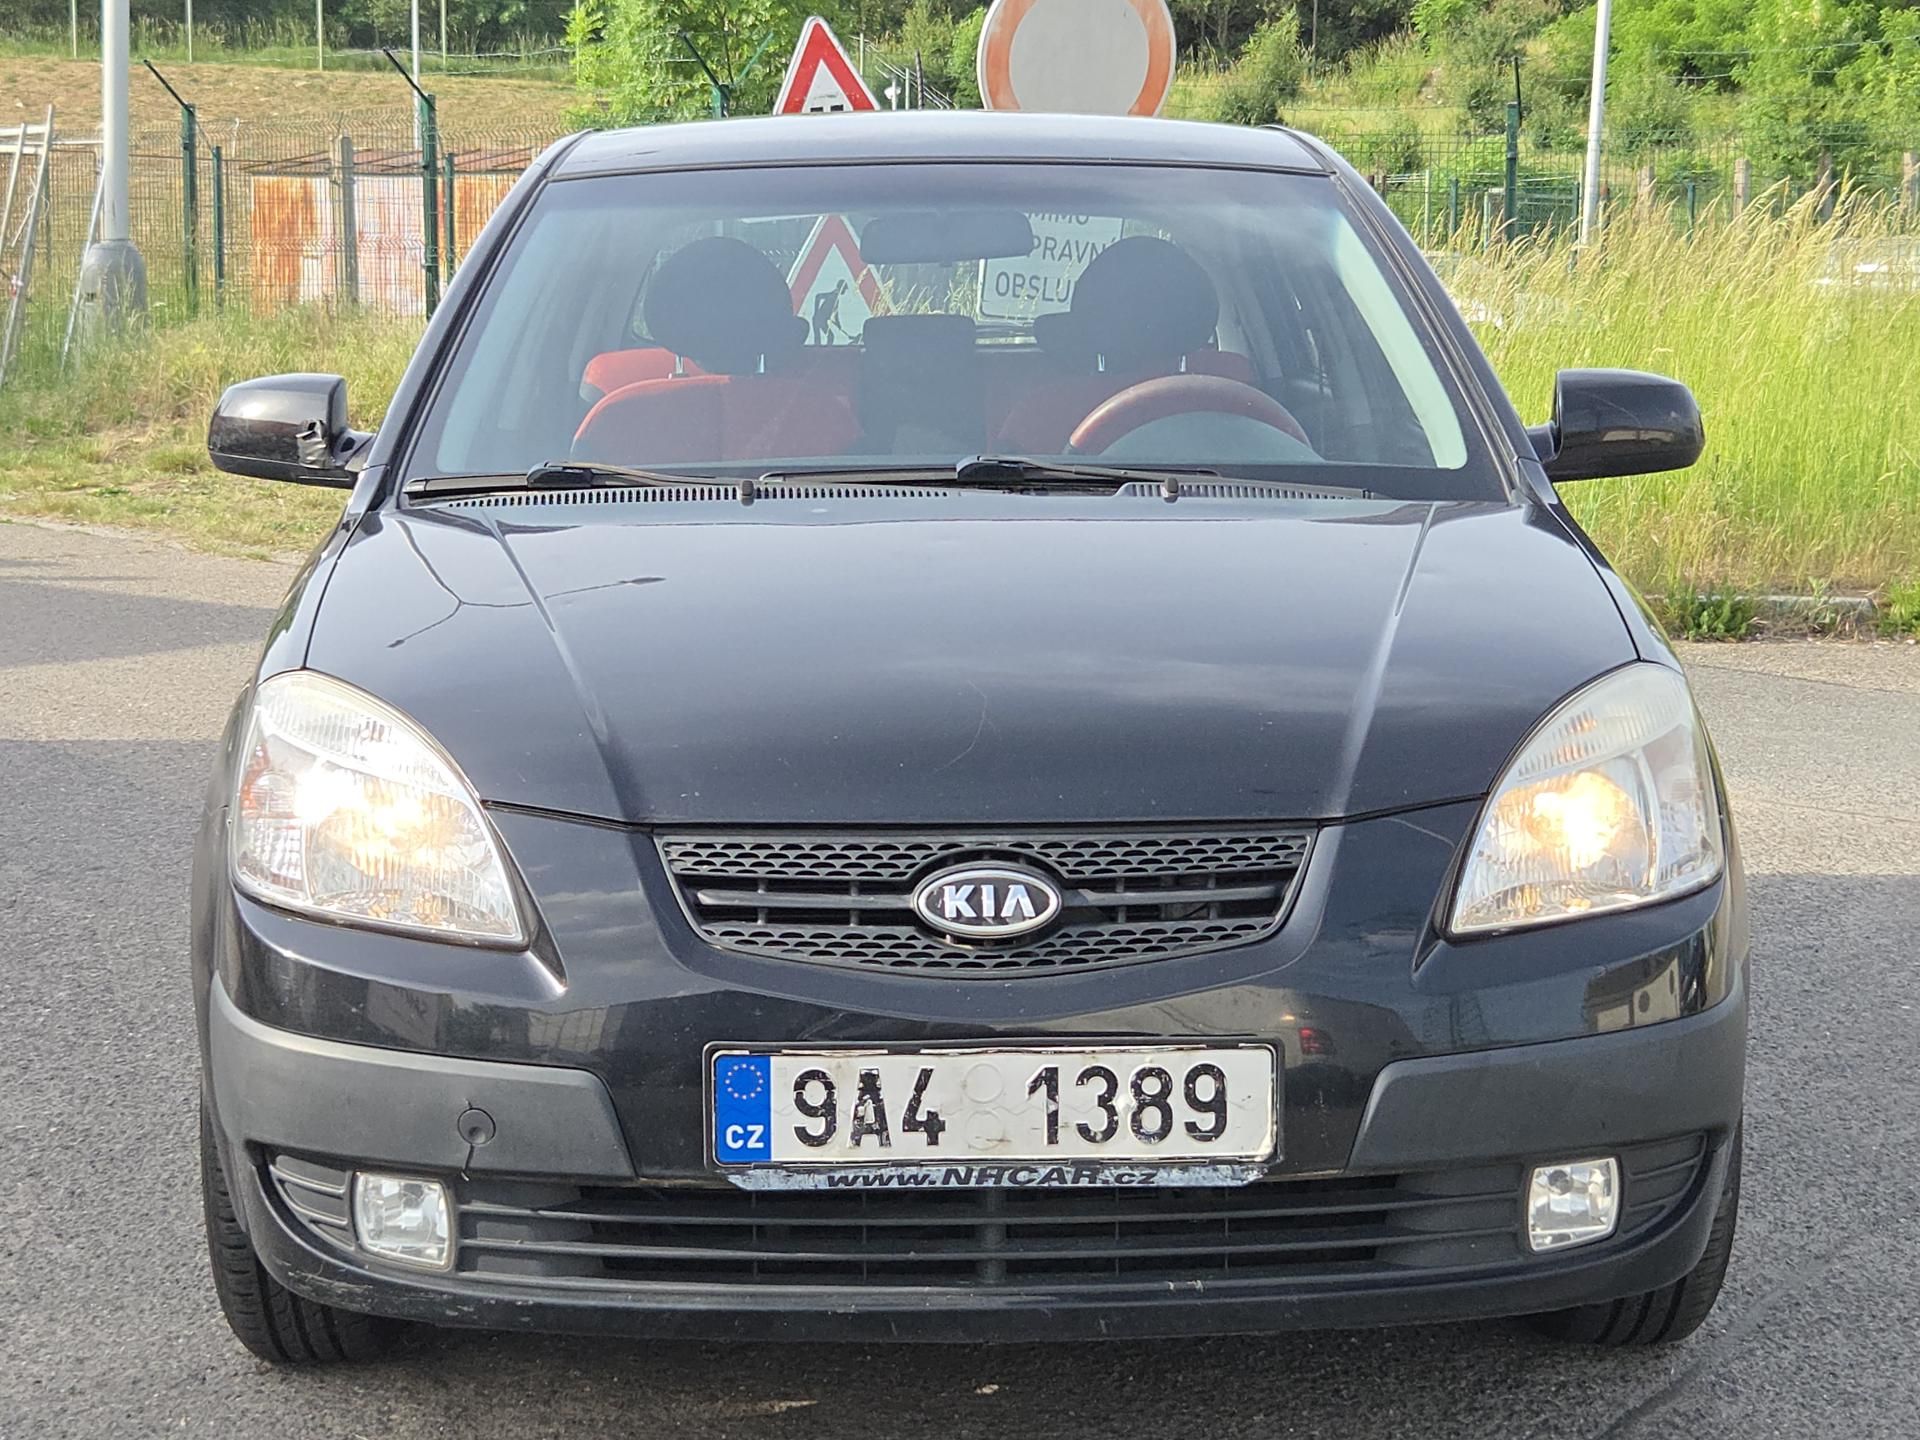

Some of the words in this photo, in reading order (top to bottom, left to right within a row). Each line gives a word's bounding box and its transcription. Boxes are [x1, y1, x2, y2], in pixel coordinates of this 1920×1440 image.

[995, 271, 1071, 303] OBSLU
[942, 884, 1036, 918] KIA
[793, 1068, 946, 1148] 9A4
[1027, 1063, 1228, 1145] 1389
[725, 1125, 764, 1149] CZ
